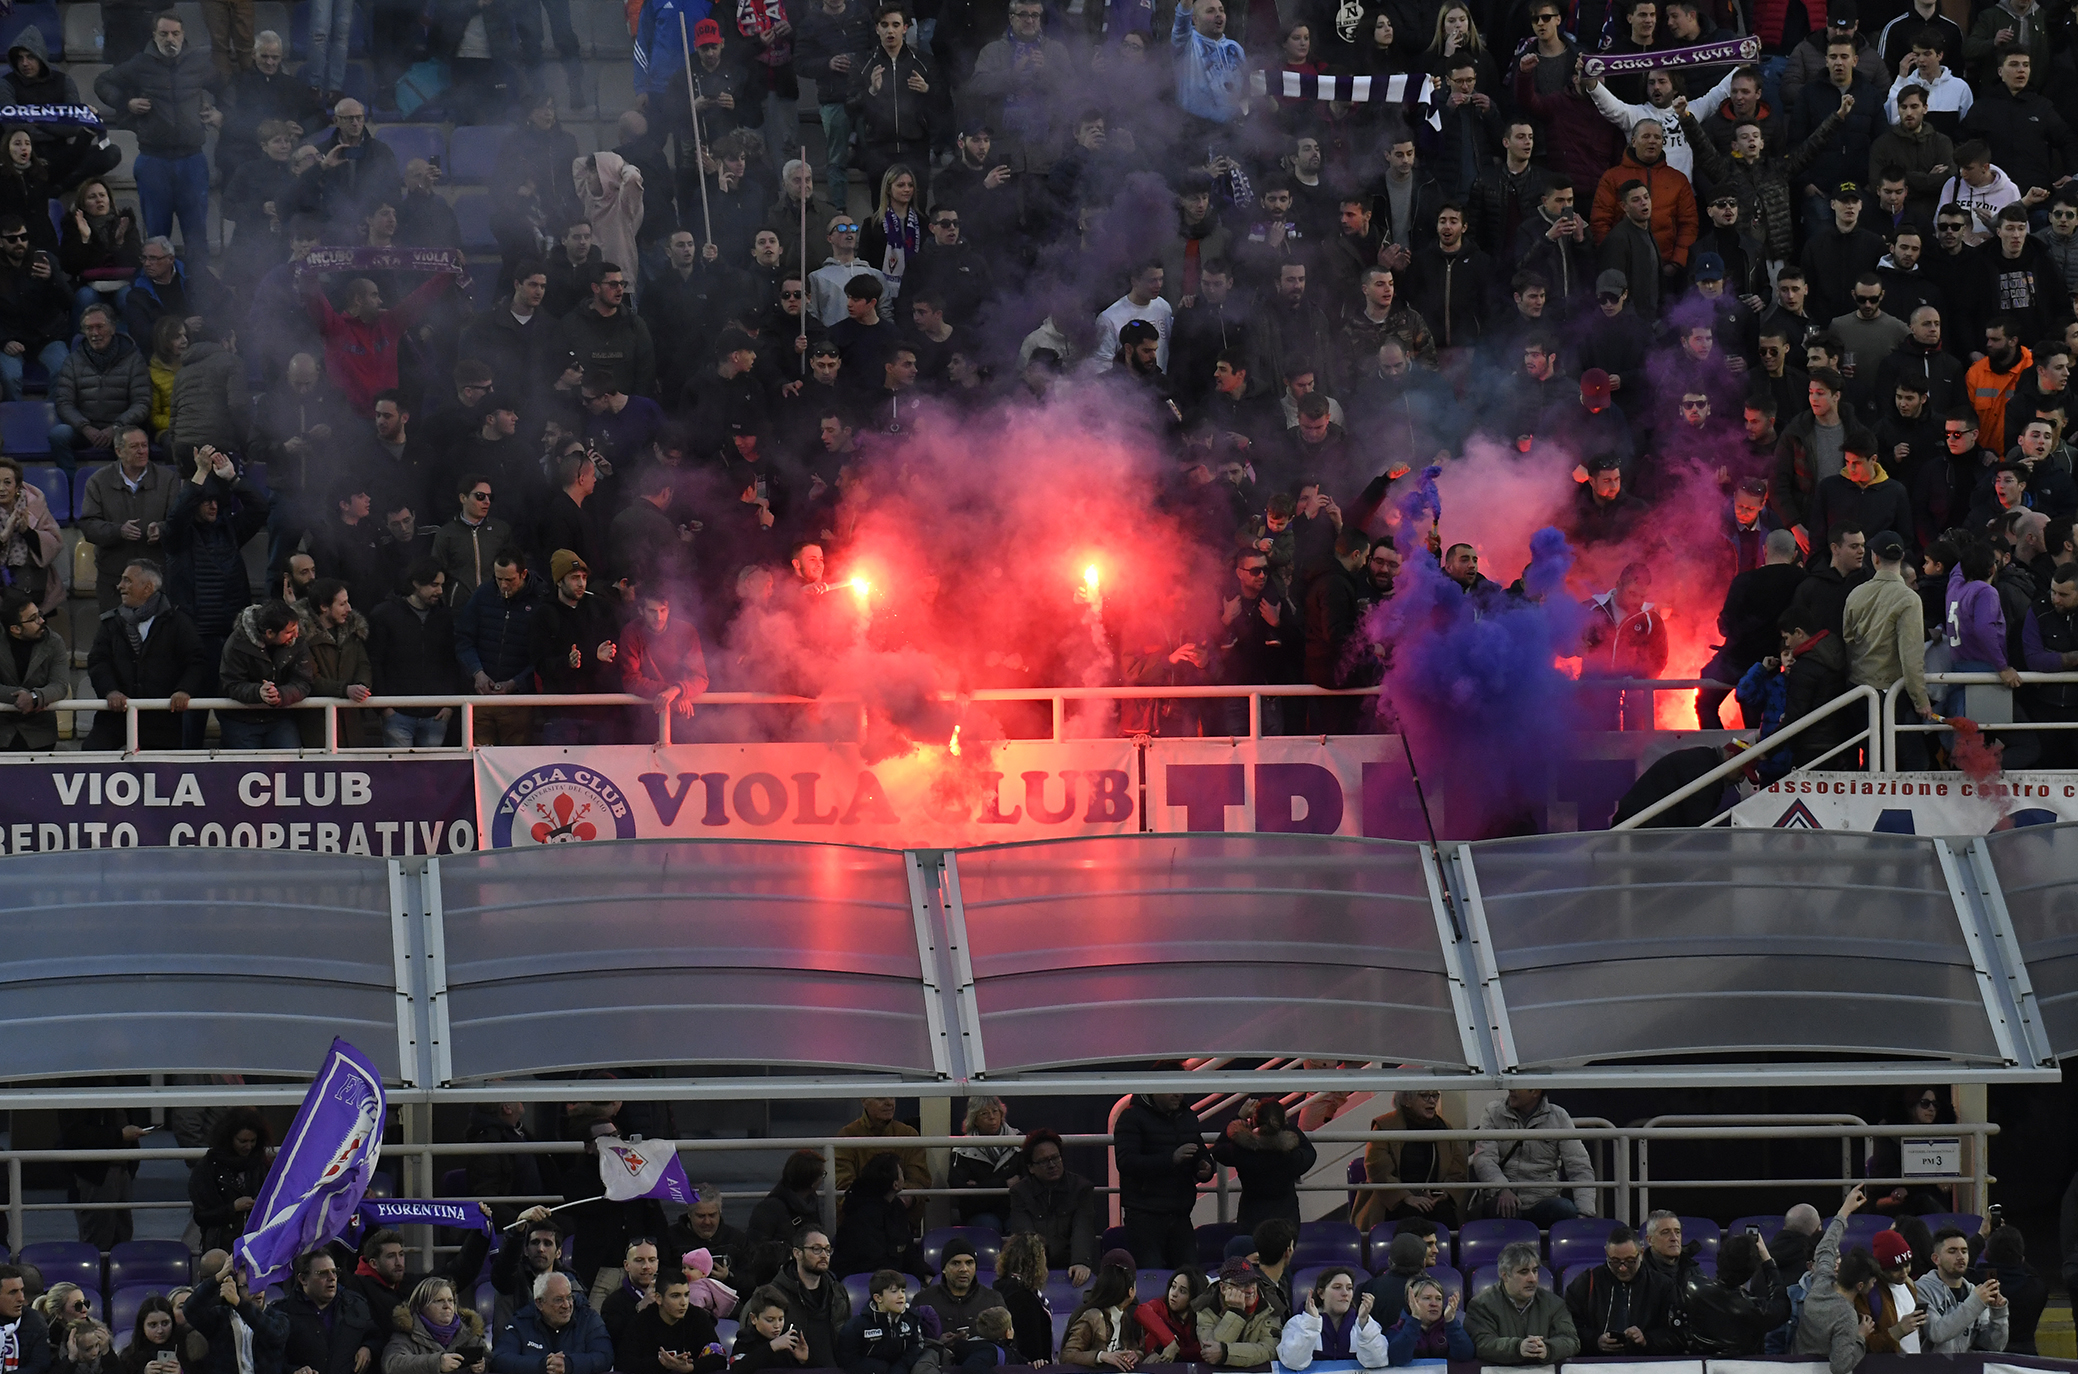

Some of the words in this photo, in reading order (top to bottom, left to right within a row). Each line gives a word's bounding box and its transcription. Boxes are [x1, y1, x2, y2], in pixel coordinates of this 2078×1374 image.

[0, 105, 99, 123] ORENTINA
[413, 251, 449, 263] VIOLA
[1947, 601, 1961, 647] 5
[52, 771, 206, 807] VIOLA
[238, 771, 373, 808] CLUB
[500, 768, 567, 815] VIOLA
[574, 770, 627, 819] CLUB
[568, 785, 583, 794] DEL
[584, 790, 608, 813] CALCIO
[638, 770, 900, 827] VIOLA
[1768, 780, 1948, 796] associazione
[2063, 784, 2075, 798] c
[0, 821, 139, 854] EDITO
[169, 819, 475, 857] COOPERATIVO
[1936, 1156, 1942, 1165] 3
[377, 1203, 465, 1220] FIORENTINA
[1894, 1250, 1912, 1264] NYC
